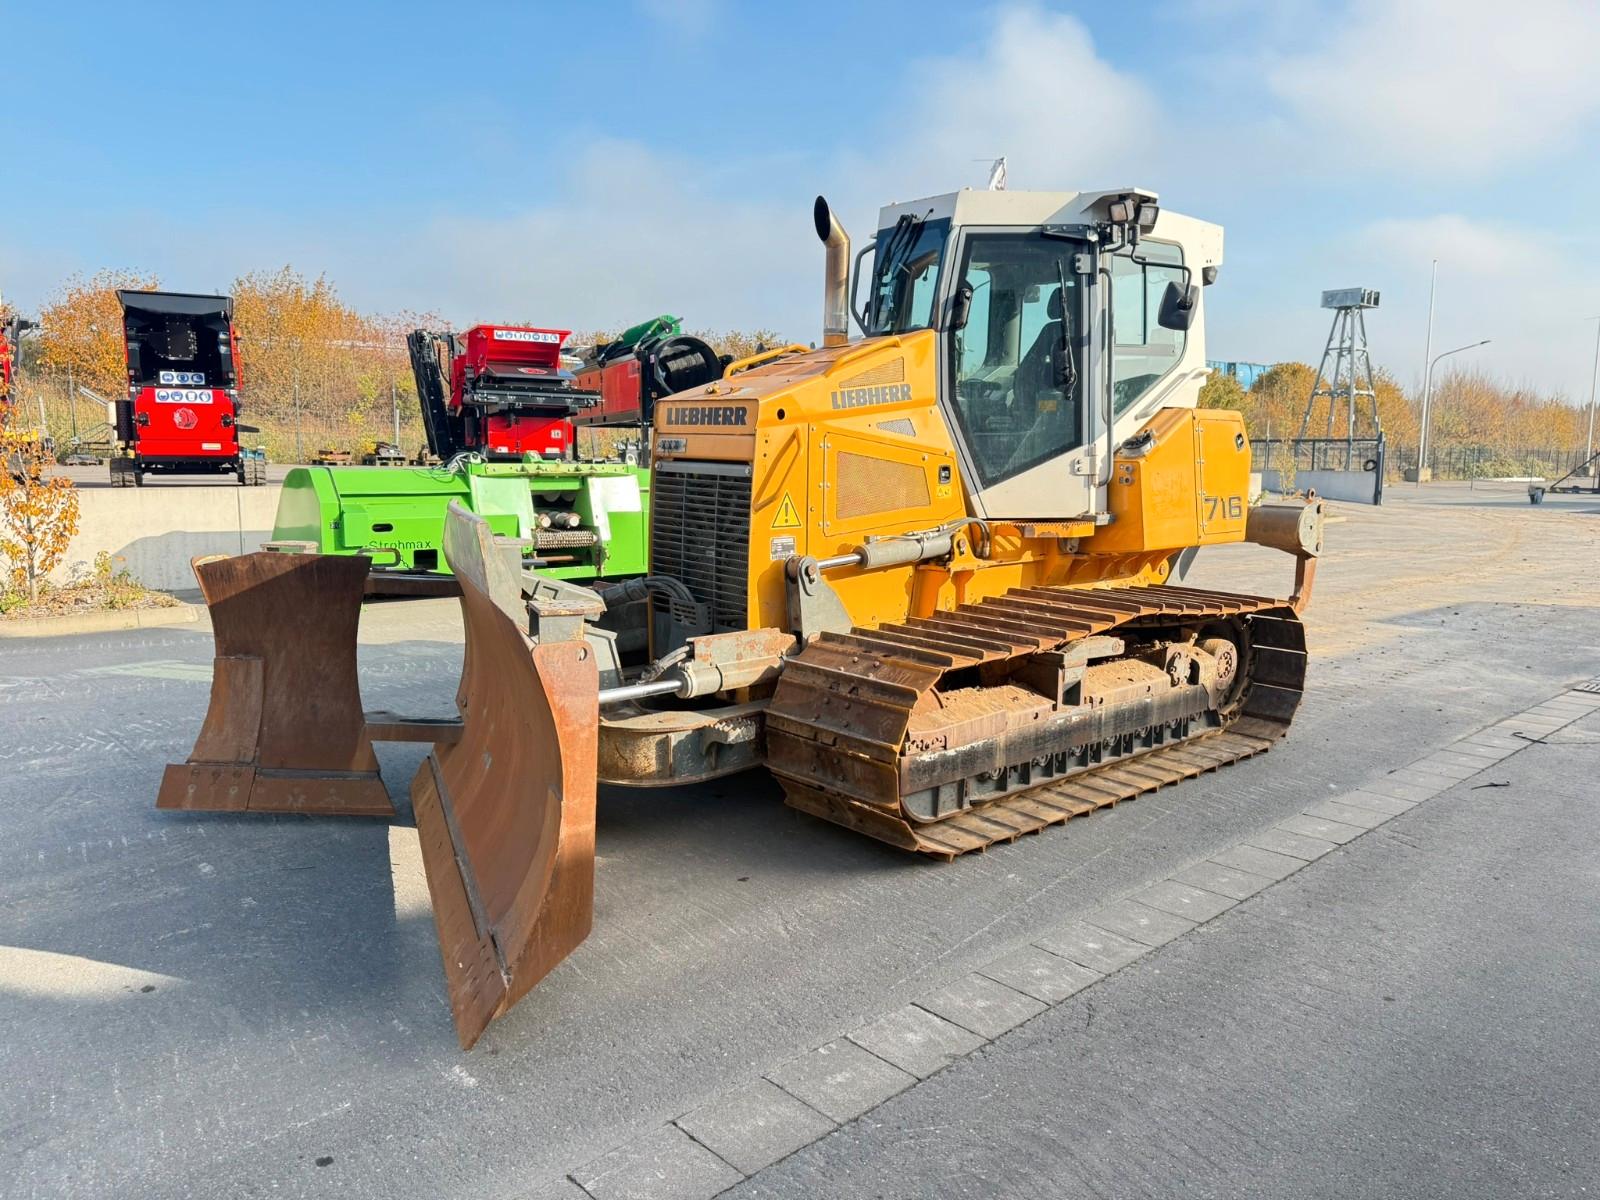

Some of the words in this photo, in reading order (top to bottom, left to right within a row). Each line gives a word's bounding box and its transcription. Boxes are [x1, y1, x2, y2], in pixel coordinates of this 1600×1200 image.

[831, 383, 912, 410] LIEBHERR
[666, 406, 748, 426] LIEBHERR
[1203, 496, 1242, 521] 716
